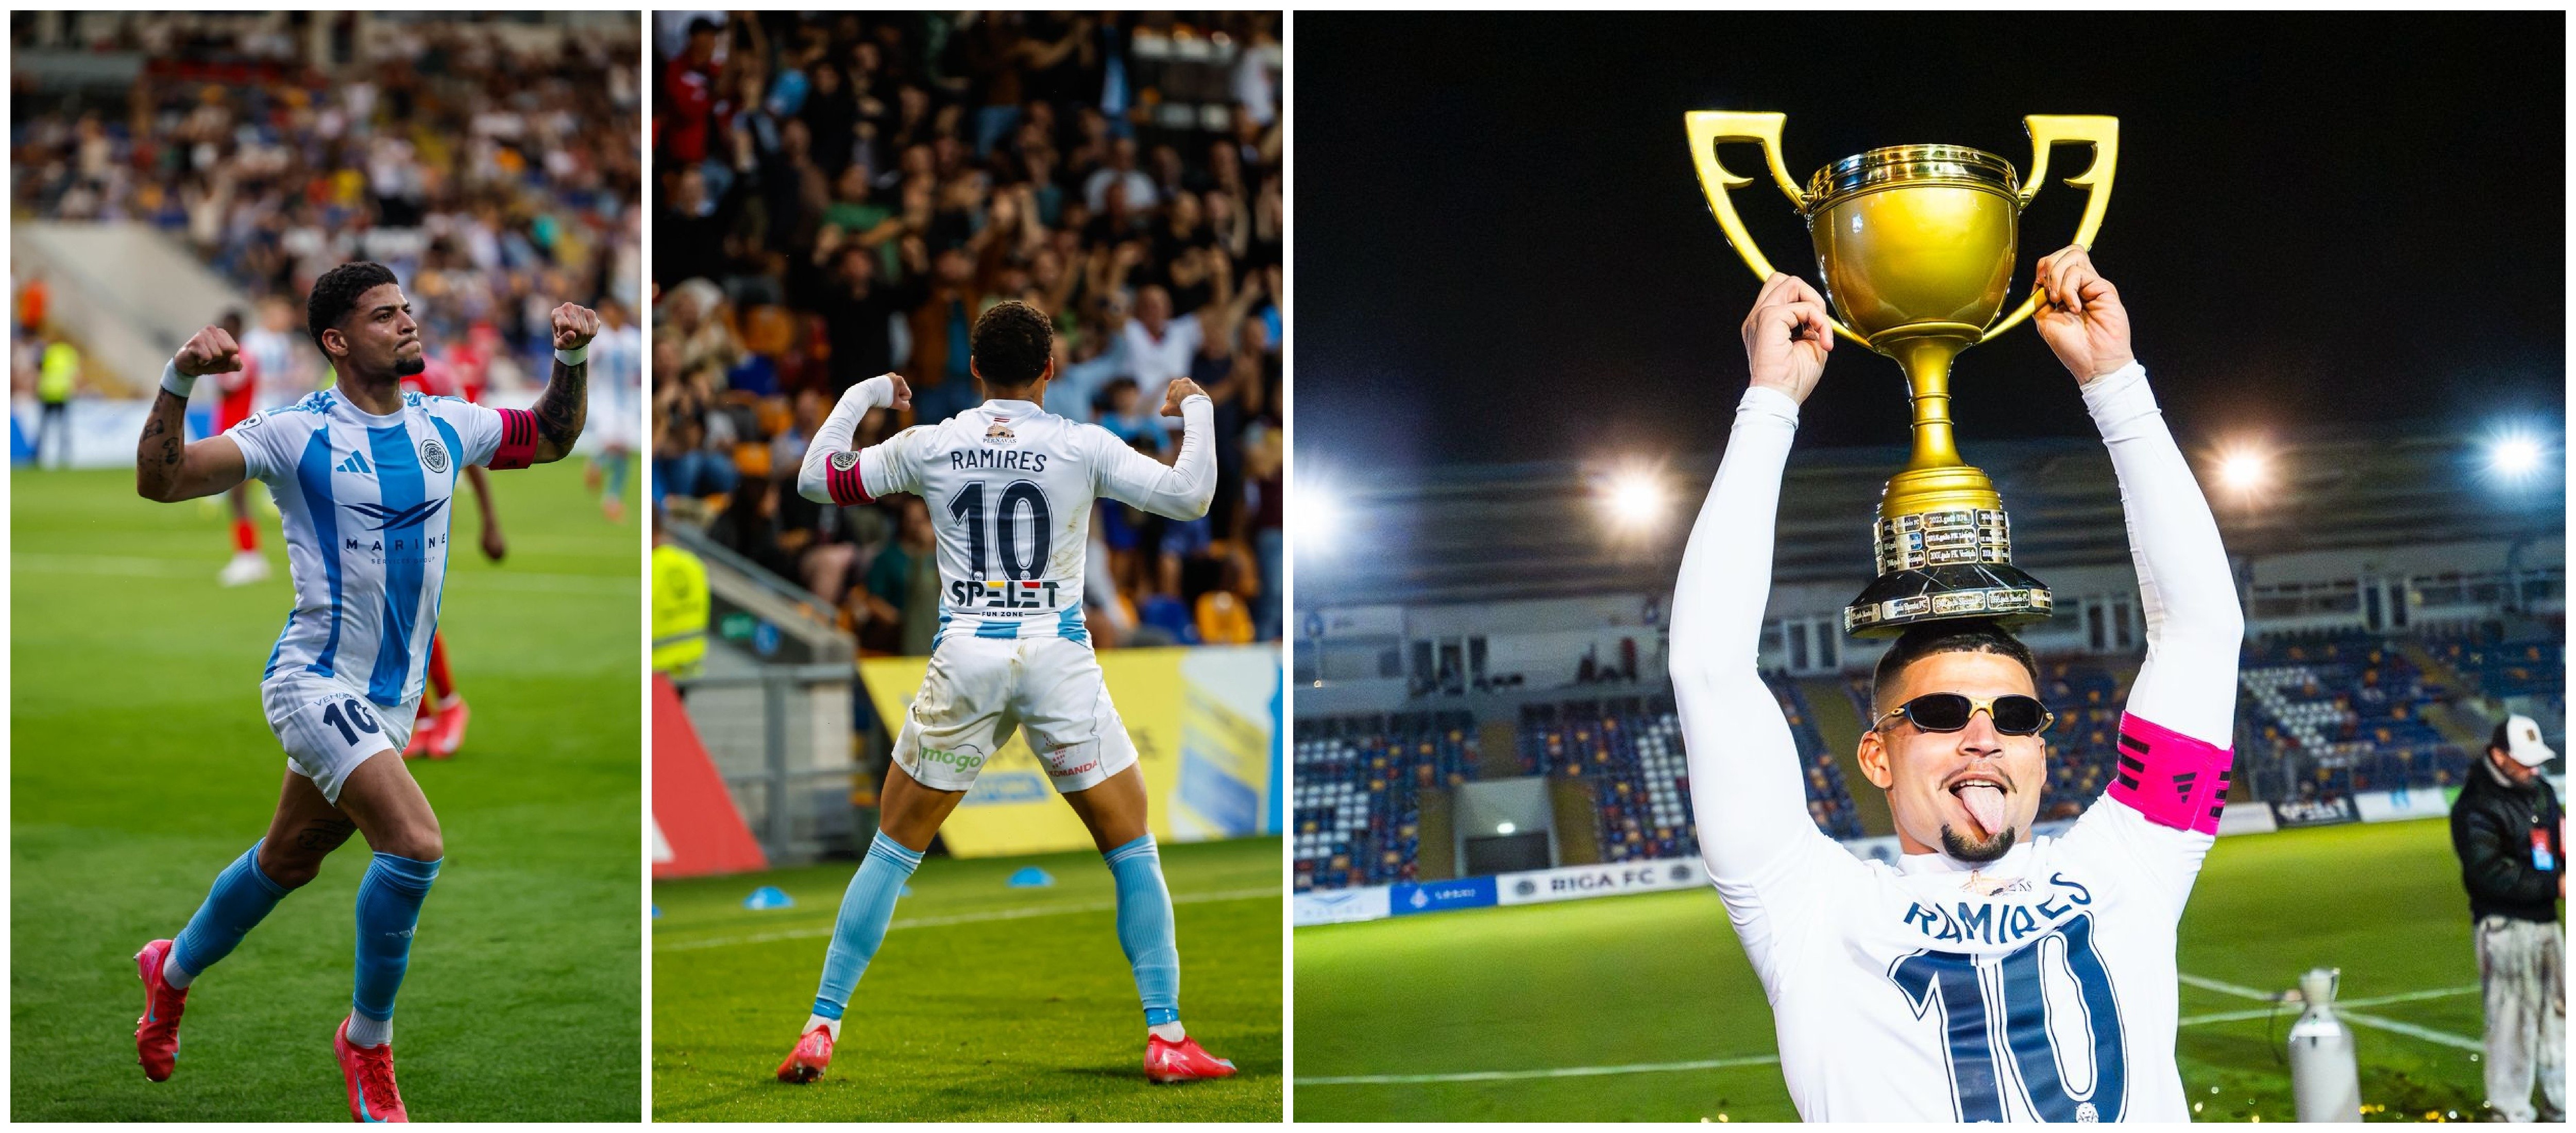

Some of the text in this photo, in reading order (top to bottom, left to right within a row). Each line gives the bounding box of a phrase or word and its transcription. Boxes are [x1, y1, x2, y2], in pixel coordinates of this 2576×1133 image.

[951, 449, 1047, 472] RAMIRES
[346, 533, 446, 551] MARINE
[947, 479, 1054, 581] 10
[952, 580, 1060, 608] SPELET
[323, 699, 380, 747] 10
[922, 747, 981, 773] mogo
[1551, 868, 1655, 892] RIGA FC
[1887, 910, 2129, 1123] 10
